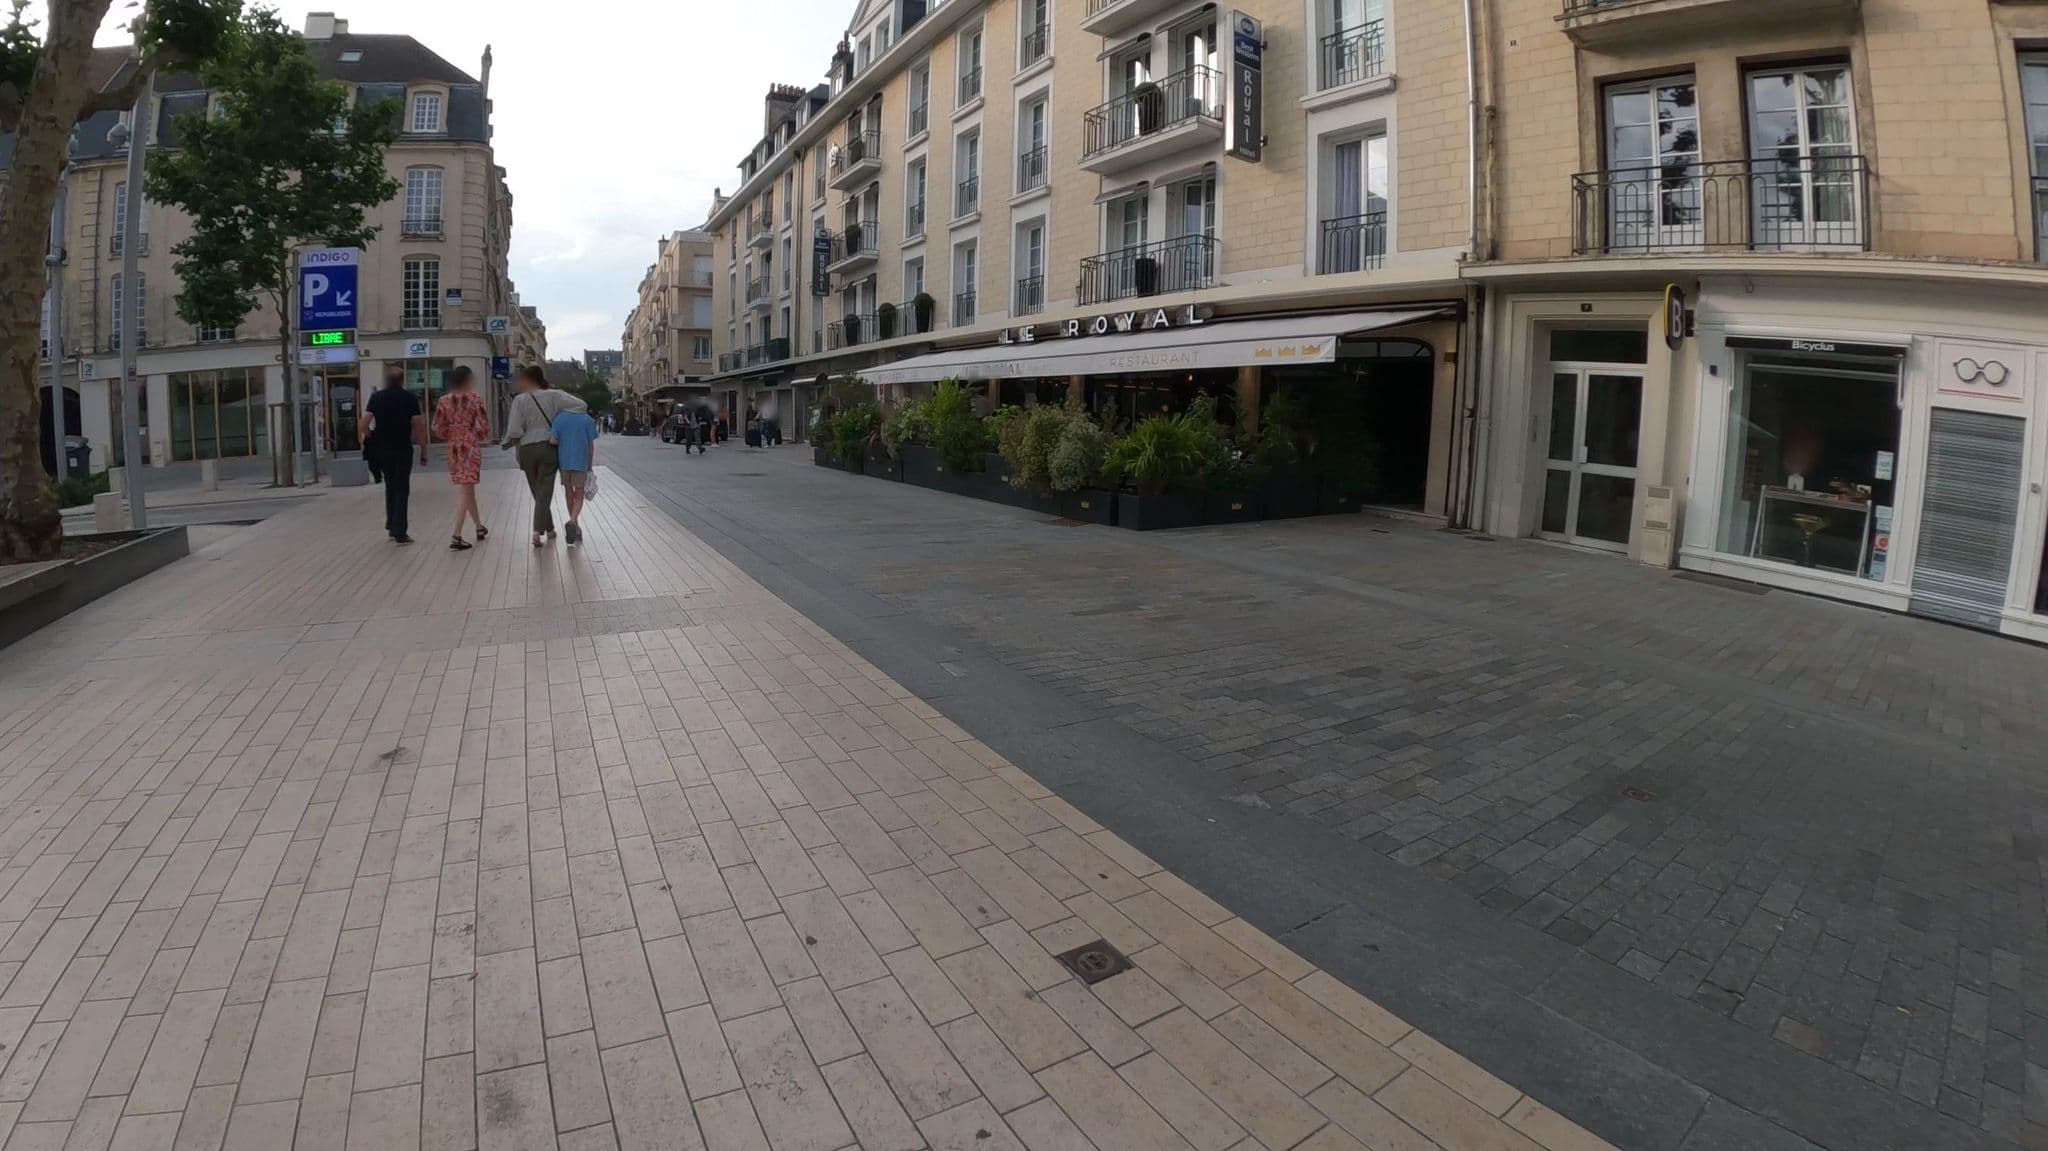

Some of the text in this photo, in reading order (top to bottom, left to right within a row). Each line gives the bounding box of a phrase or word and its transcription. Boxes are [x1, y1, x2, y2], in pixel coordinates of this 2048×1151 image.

[1240, 42, 1254, 53] Best
[1243, 70, 1253, 143] Royal
[303, 273, 329, 308] P
[1003, 304, 1205, 345] LE ROYAL
[1671, 299, 1682, 338] B
[312, 332, 344, 345] LIBRE
[1791, 340, 1836, 352] Bicyclus
[1110, 351, 1200, 369] RESTAURANT
